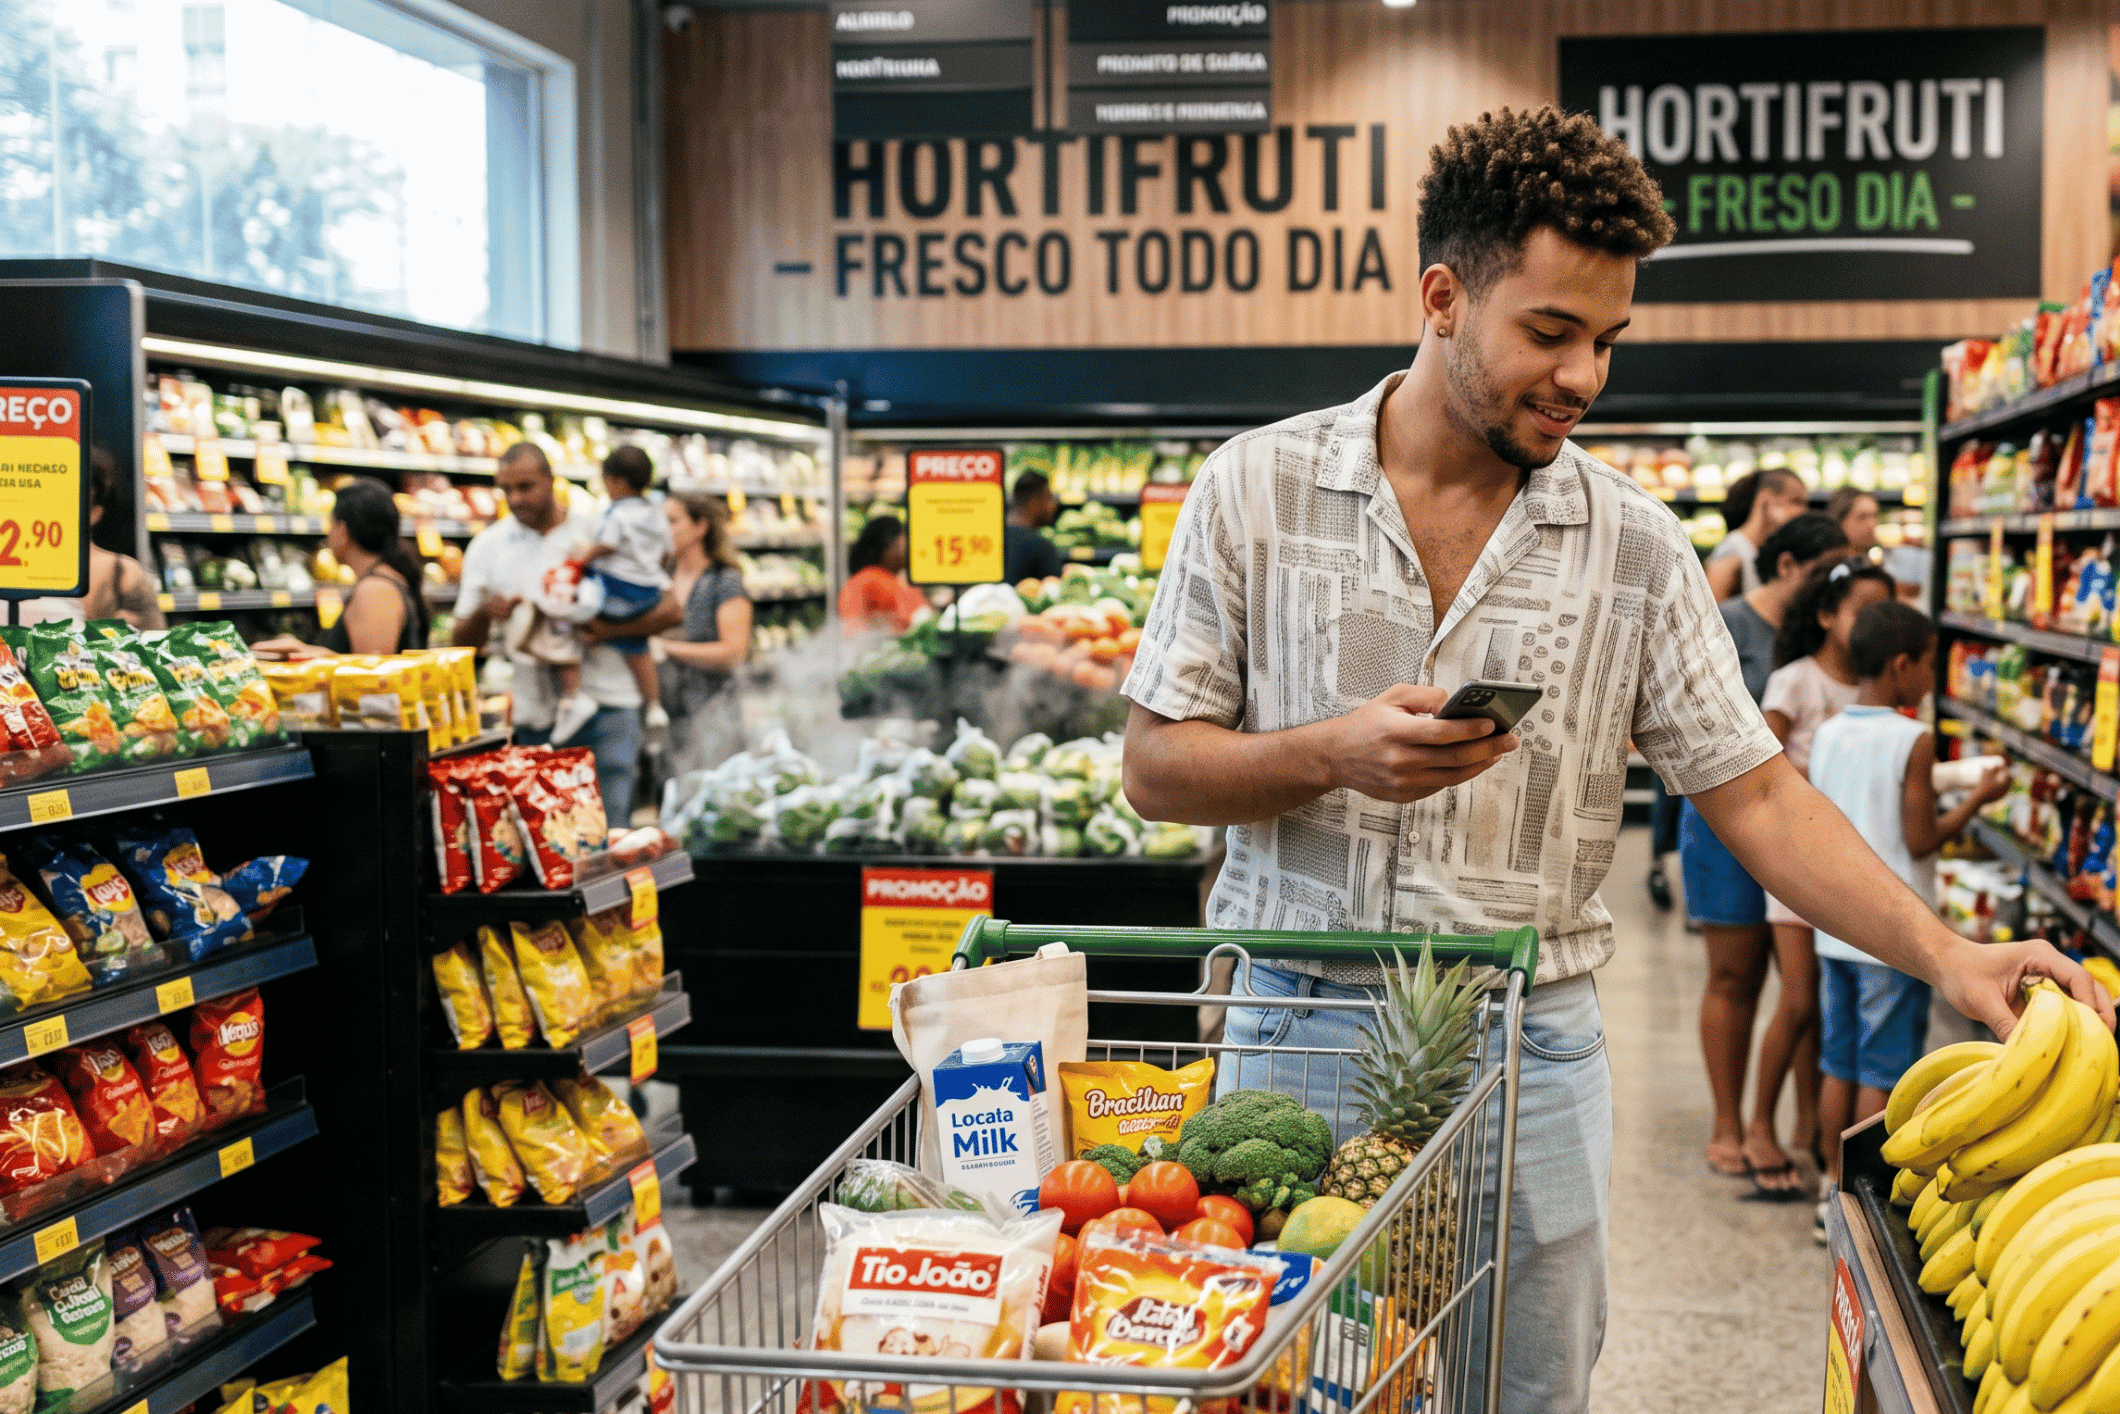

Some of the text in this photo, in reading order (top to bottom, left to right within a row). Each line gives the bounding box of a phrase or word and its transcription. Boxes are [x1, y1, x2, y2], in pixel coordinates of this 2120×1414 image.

[1601, 79, 2004, 163] HORTIFRUTI
[833, 124, 1387, 219] HORTIFRUTI
[1688, 171, 1940, 232] FRESO DIA
[836, 226, 1394, 298] FRESCO TODO DIA
[916, 455, 996, 481] PREÇO
[866, 877, 989, 905] PROMOÇÃO
[951, 1107, 1014, 1128] Locata
[952, 1127, 1020, 1159] Milk
[861, 1256, 993, 1291] Tio João
